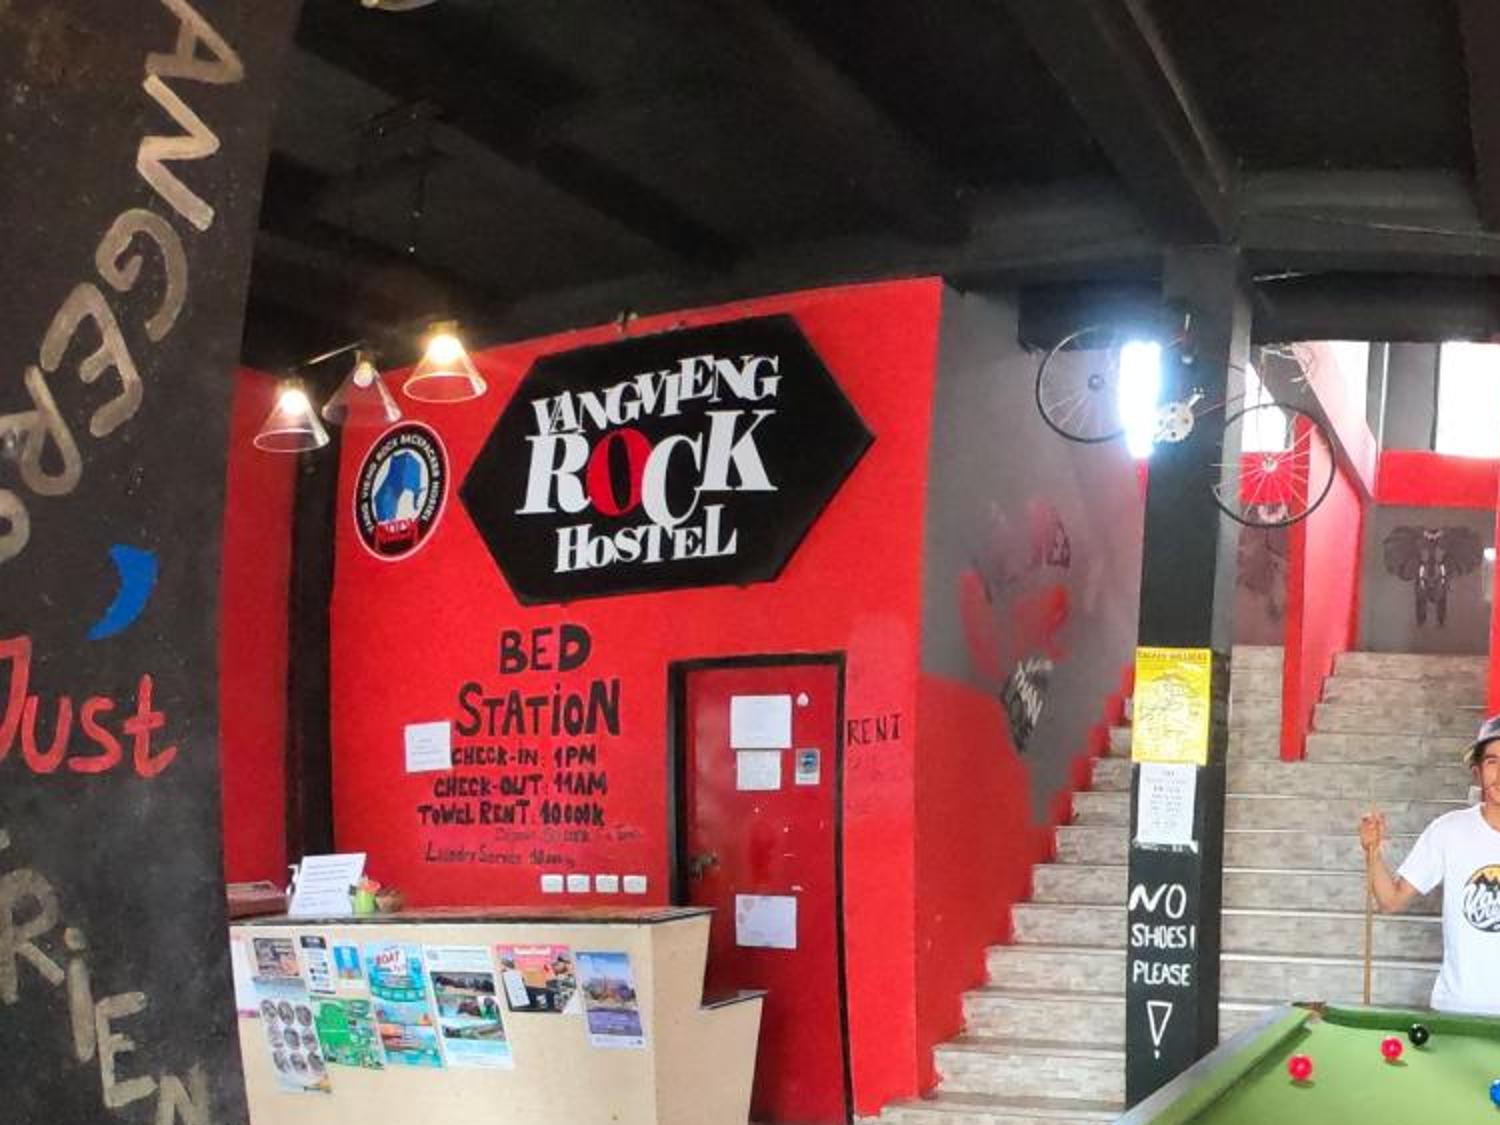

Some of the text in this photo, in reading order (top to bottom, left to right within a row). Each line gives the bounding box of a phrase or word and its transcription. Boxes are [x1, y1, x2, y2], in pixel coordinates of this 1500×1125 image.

[515, 409, 779, 528] ROCK
[500, 624, 592, 674] BED
[847, 714, 902, 747] RENT
[554, 744, 597, 769] 1PM
[1128, 884, 1187, 920] NO
[1133, 960, 1191, 987] PLEASE
